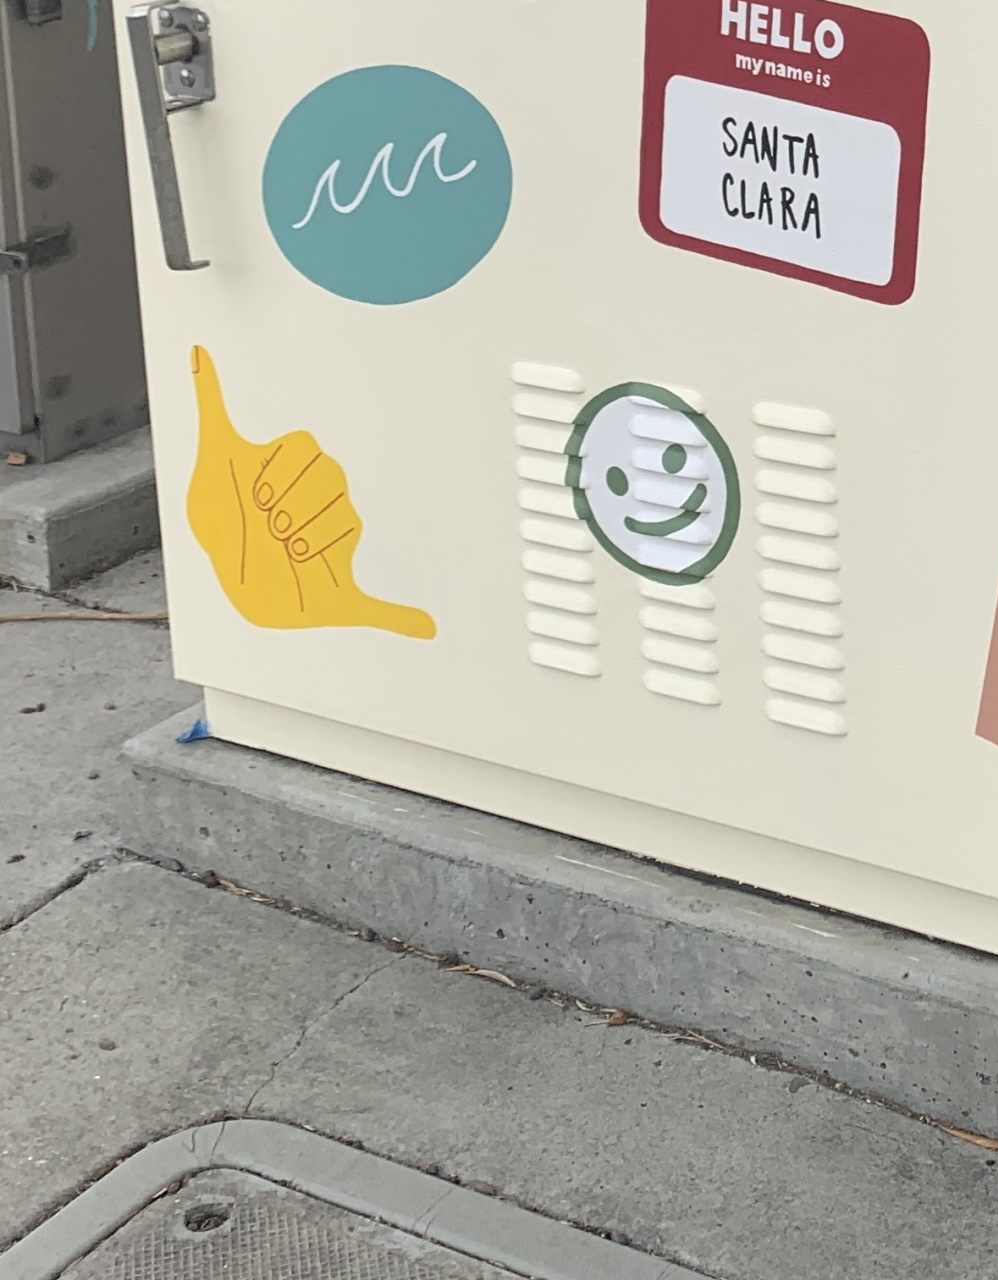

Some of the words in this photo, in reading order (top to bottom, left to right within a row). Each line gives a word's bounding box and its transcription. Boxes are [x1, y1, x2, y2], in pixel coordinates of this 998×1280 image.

[735, 52, 763, 76] my
[763, 60, 814, 84] name
[816, 68, 831, 88] is
[722, 117, 820, 179] SANTA
[722, 173, 822, 239] CLARA
